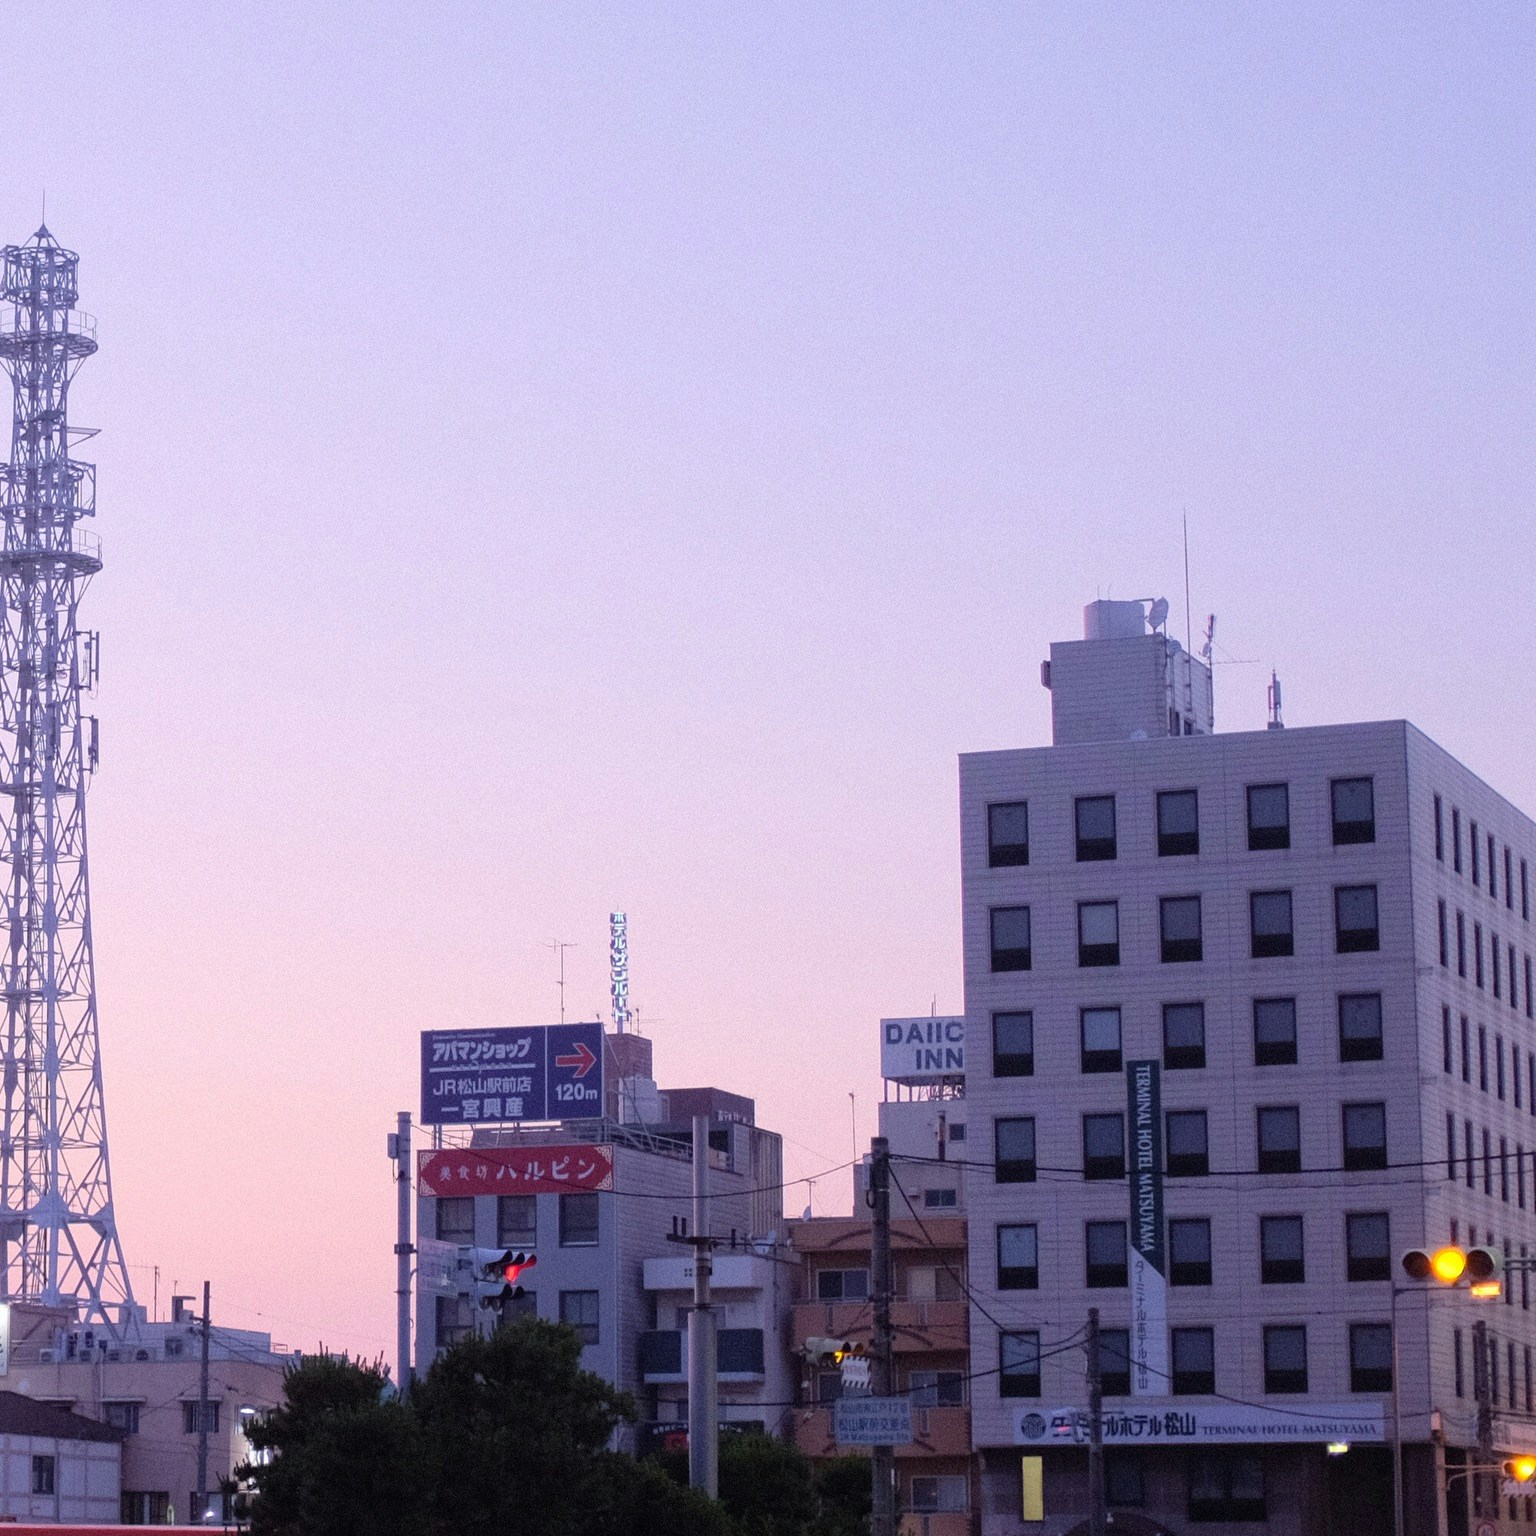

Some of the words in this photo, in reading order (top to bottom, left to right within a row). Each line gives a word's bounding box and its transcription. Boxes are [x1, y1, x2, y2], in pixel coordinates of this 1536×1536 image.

[611, 912, 628, 1022] ホテルサンルート
[885, 1021, 964, 1044] DAIIC
[432, 1037, 532, 1062] アパマンショップ
[916, 1047, 963, 1070] INN
[432, 1076, 532, 1096] JR松山駅前店
[555, 1083, 597, 1101] 120m
[1136, 1064, 1151, 1126] TERMINAL
[440, 1096, 524, 1119] 一宮興産
[1137, 1129, 1153, 1170] HOTEL
[495, 1155, 596, 1181] ハルピン
[1139, 1173, 1155, 1252] MATSUYAMA
[1203, 1425, 1258, 1435] TERMINAL
[1262, 1424, 1299, 1435] HOTEL
[1303, 1424, 1377, 1434] MATSUYAMA
